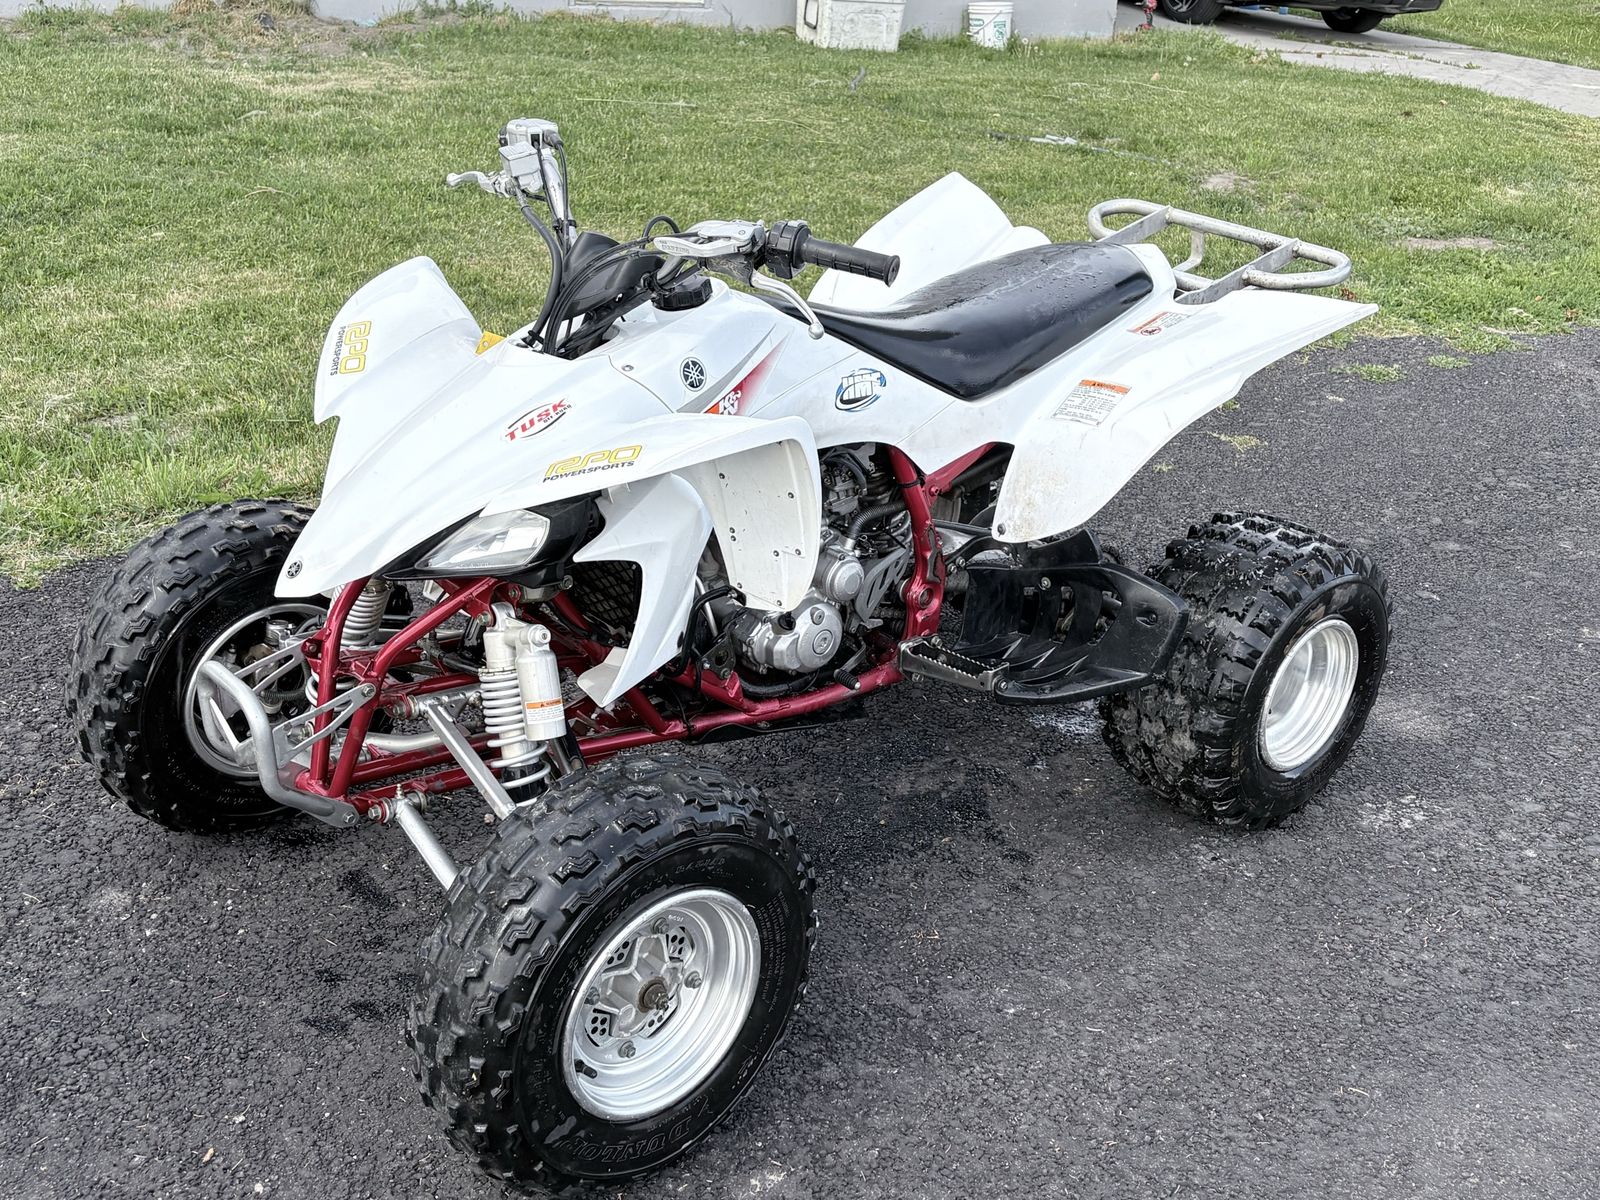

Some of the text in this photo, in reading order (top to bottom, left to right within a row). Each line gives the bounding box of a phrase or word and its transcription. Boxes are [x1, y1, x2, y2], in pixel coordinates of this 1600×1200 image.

[330, 325, 347, 377] POWERSPORTS
[504, 397, 567, 441] TUSK
[542, 460, 635, 483] POWERSPORTS
